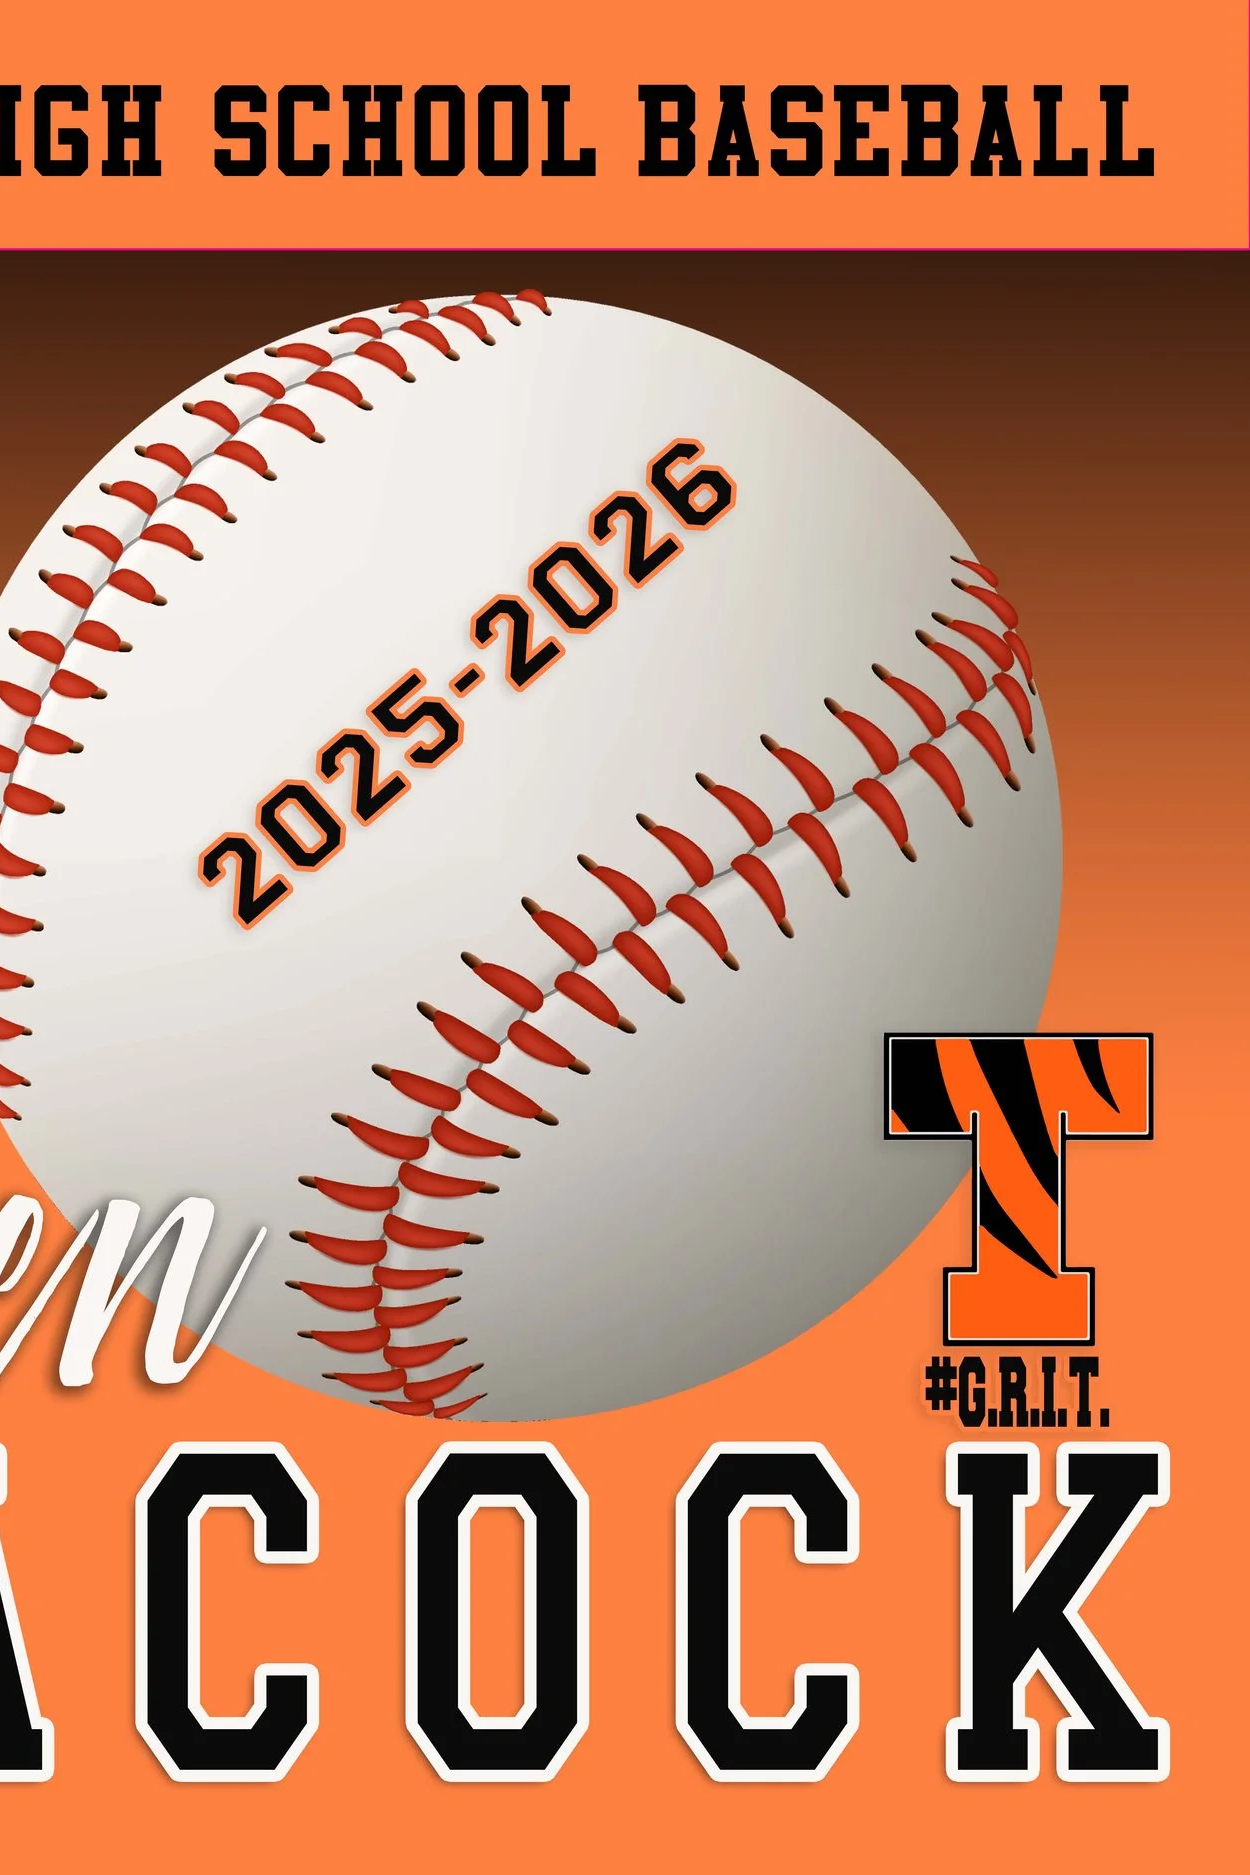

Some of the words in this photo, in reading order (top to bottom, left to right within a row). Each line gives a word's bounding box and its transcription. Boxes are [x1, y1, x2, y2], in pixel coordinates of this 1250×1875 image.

[215, 85, 596, 176] SCHOOL
[638, 85, 1154, 176] BASEBALL
[198, 438, 737, 930] 2025-2026
[884, 1032, 1153, 1346] T
[926, 1357, 1109, 1427] #G.R.I.T.
